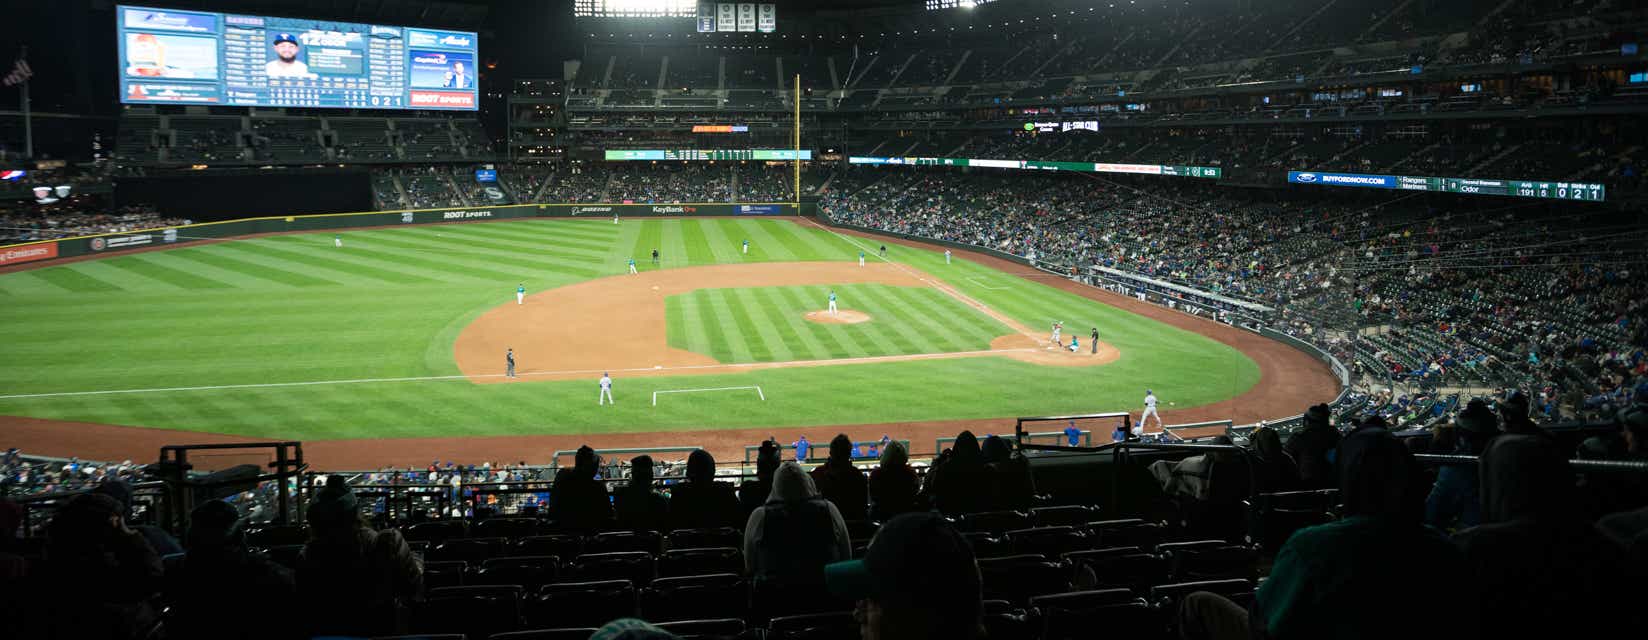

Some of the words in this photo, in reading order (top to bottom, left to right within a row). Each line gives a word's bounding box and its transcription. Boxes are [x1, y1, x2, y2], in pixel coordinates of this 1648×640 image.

[371, 97, 379, 105] 0
[384, 97, 391, 105] 2
[1558, 189, 1566, 198] 0
[1574, 190, 1582, 199] 2
[1591, 190, 1597, 199] 1
[653, 206, 684, 214] KeyBank
[444, 211, 466, 219] ROOT
